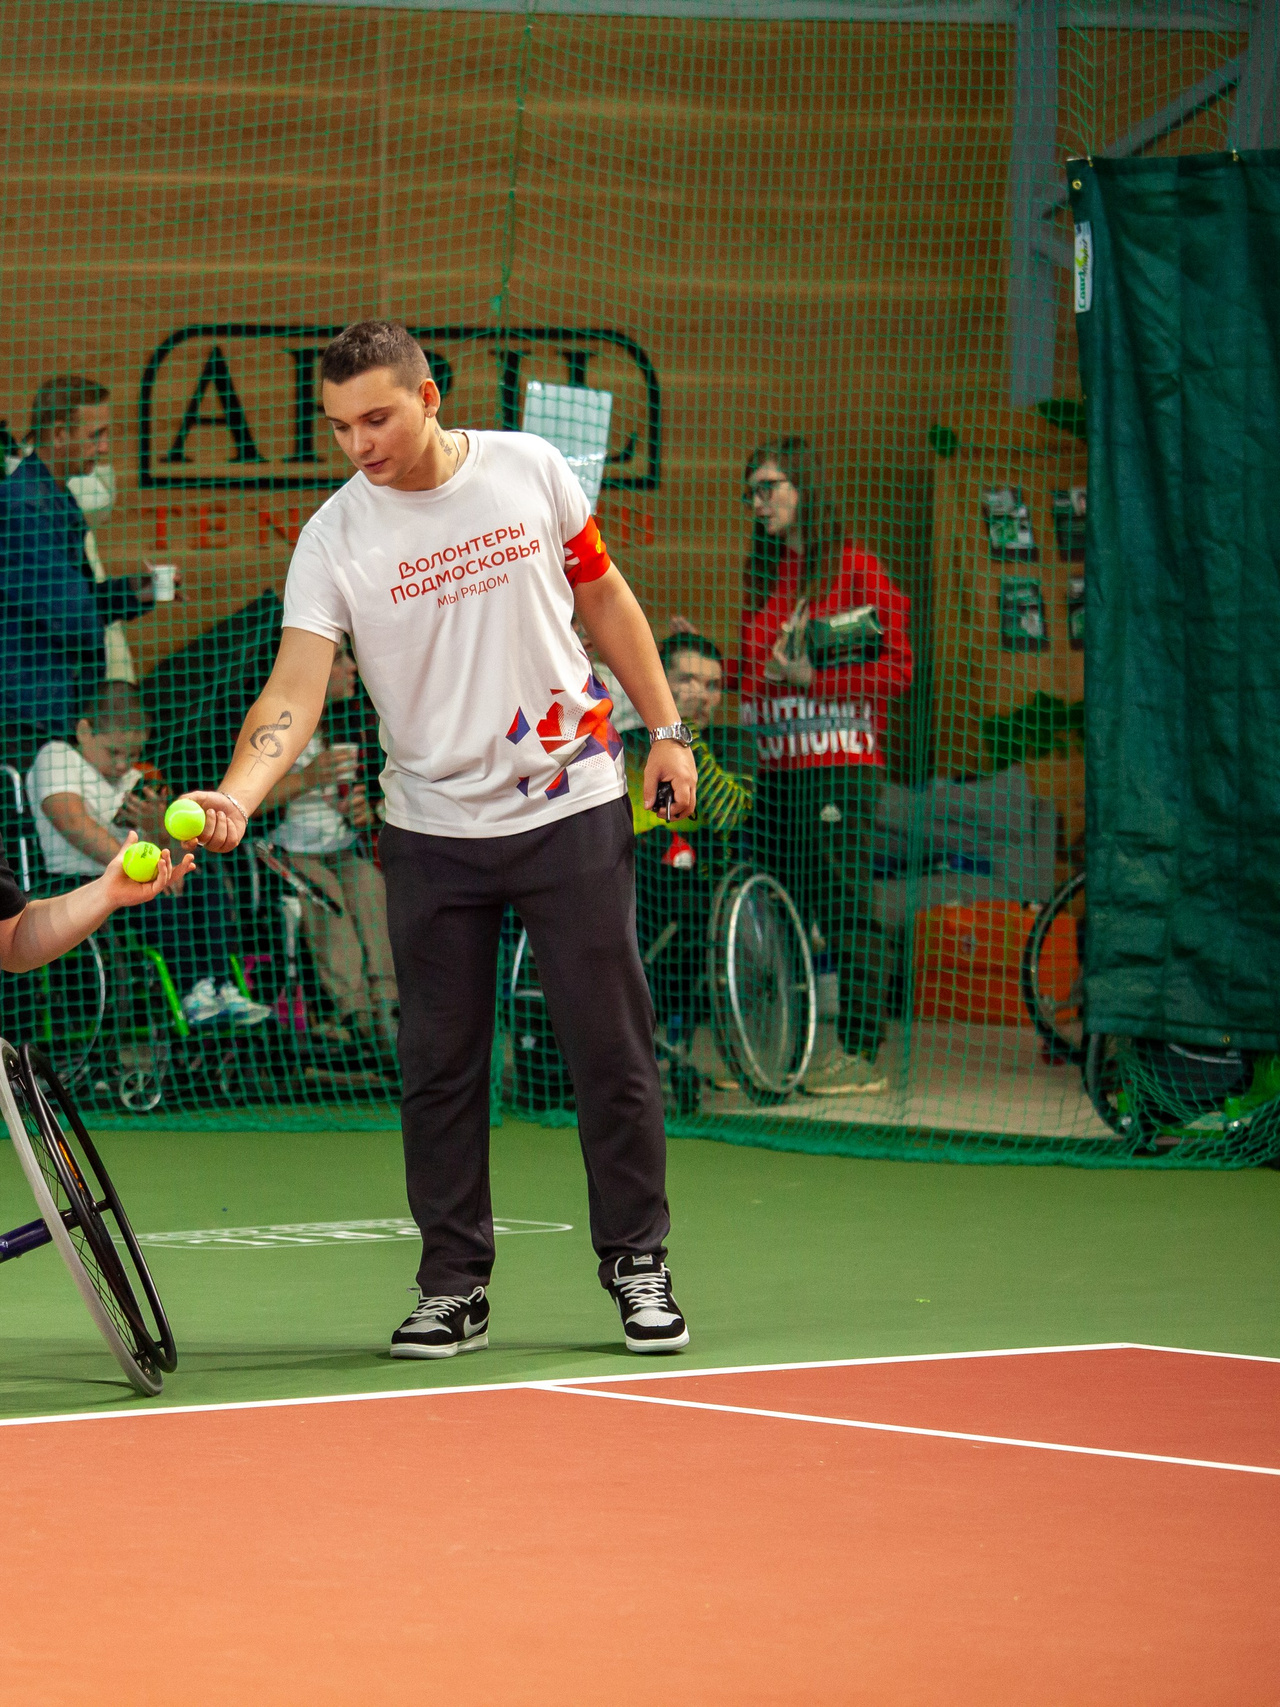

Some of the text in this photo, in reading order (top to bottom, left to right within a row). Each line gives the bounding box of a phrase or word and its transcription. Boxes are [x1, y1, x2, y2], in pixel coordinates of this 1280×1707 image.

[390, 539, 540, 604] ПОДМОСКОВЬЯ
[437, 573, 509, 609] МЫ РЯДОМ
